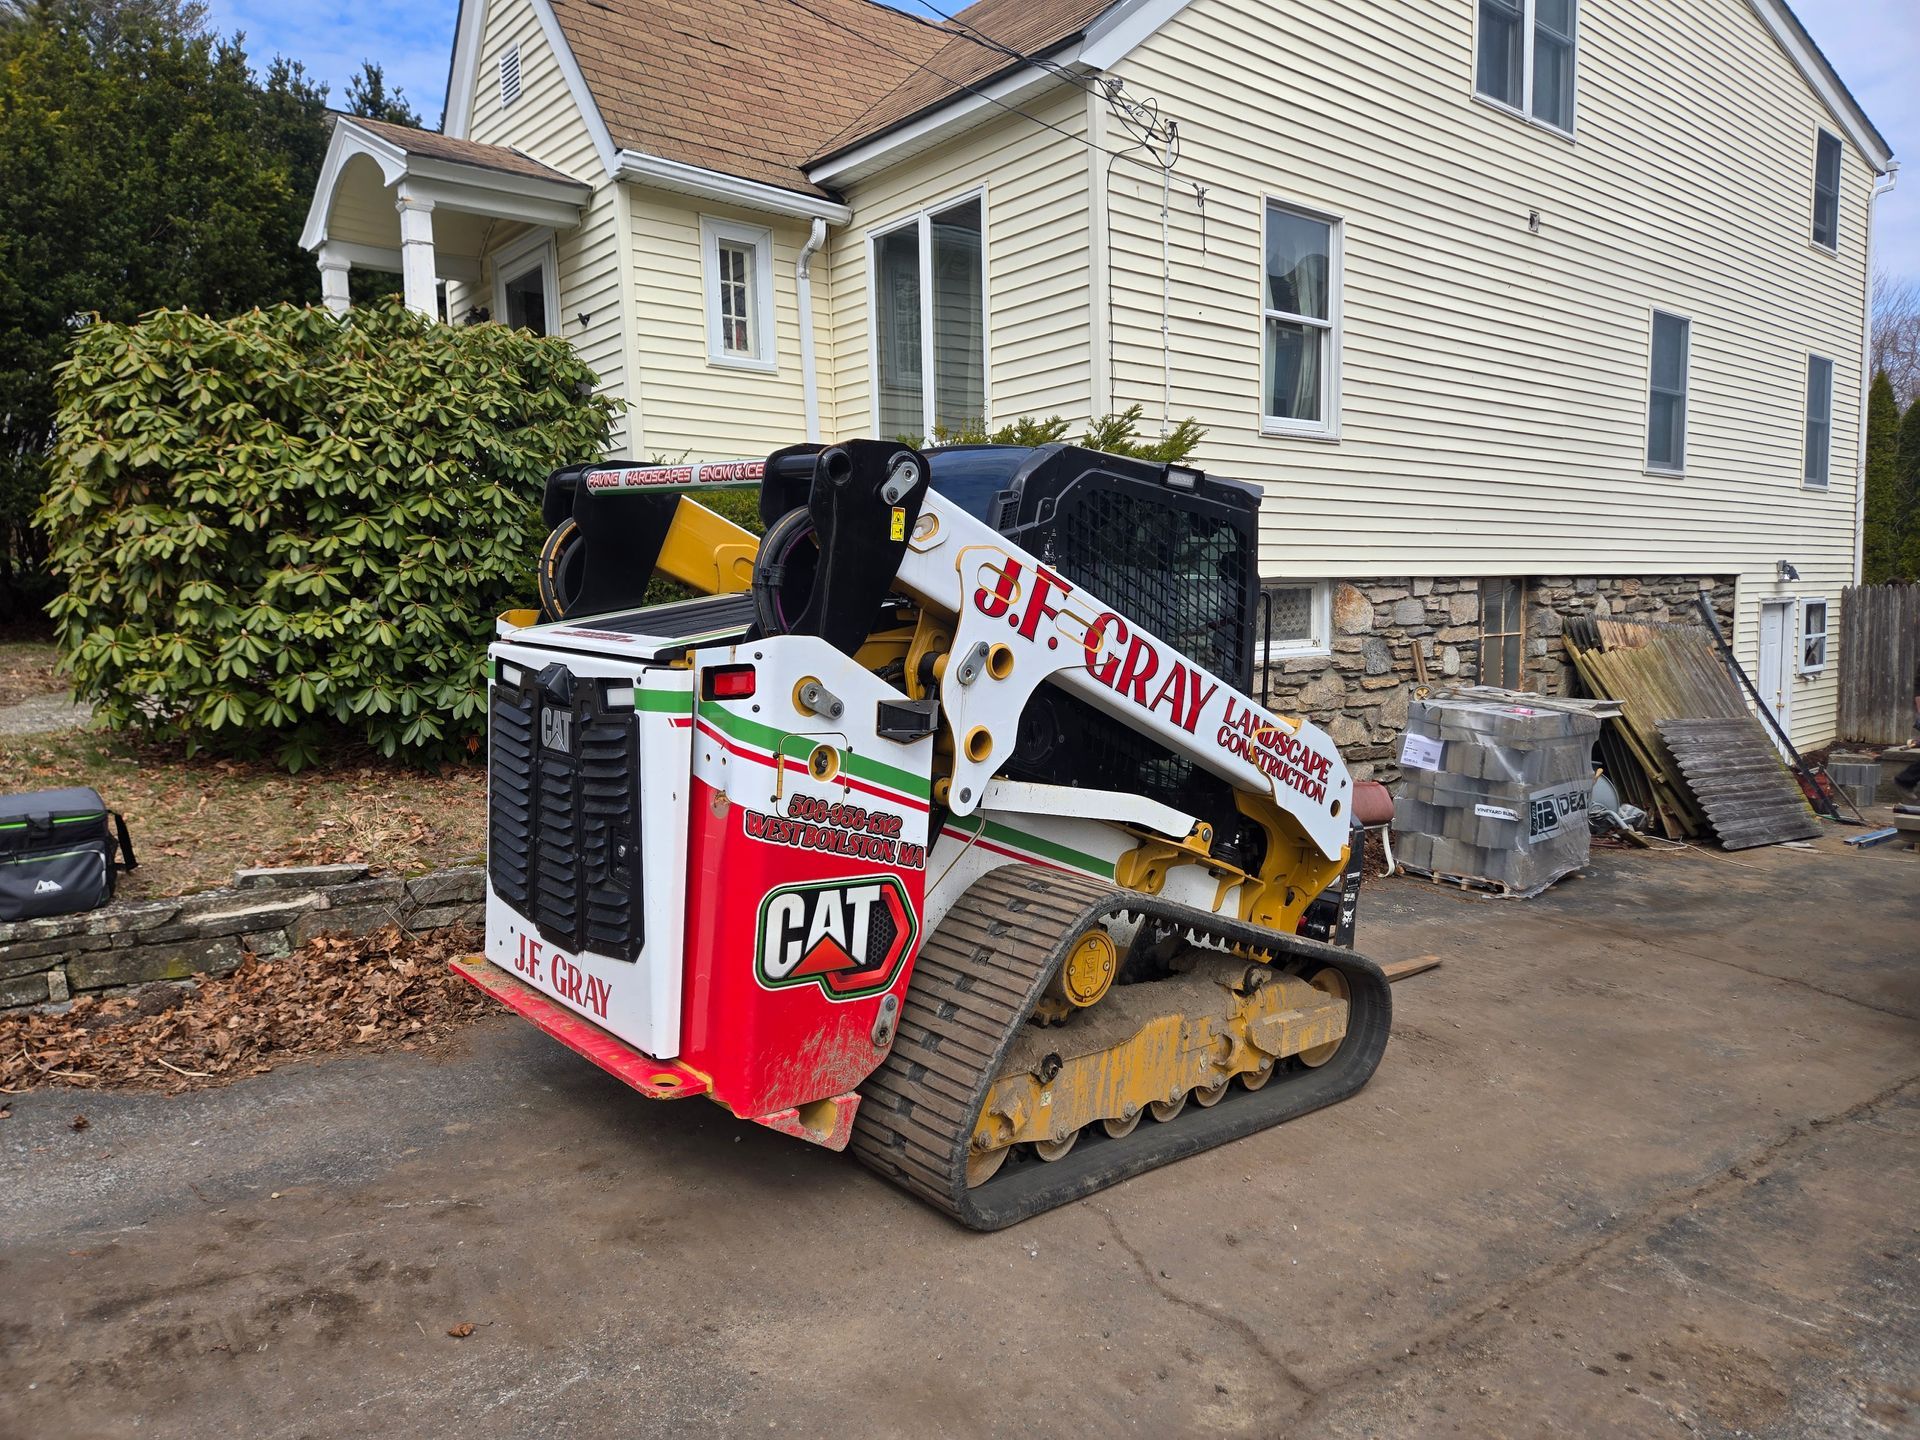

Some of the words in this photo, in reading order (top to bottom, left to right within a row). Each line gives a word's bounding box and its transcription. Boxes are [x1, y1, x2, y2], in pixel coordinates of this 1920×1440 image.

[588, 472, 620, 488] PAVING
[625, 467, 693, 486] HARDSCAPES
[973, 557, 1074, 650] J.F.
[1084, 612, 1219, 735] GRAY
[541, 706, 572, 753] CAT
[1217, 725, 1327, 805] CONSTRUCTION
[1222, 695, 1334, 785] LANDSCAPE
[747, 811, 804, 842] WEST
[897, 842, 925, 868] MA
[788, 794, 903, 838] 508-958-1312
[764, 884, 881, 979] CAT
[514, 932, 544, 982] J.F.
[550, 953, 613, 1020] GRAY
